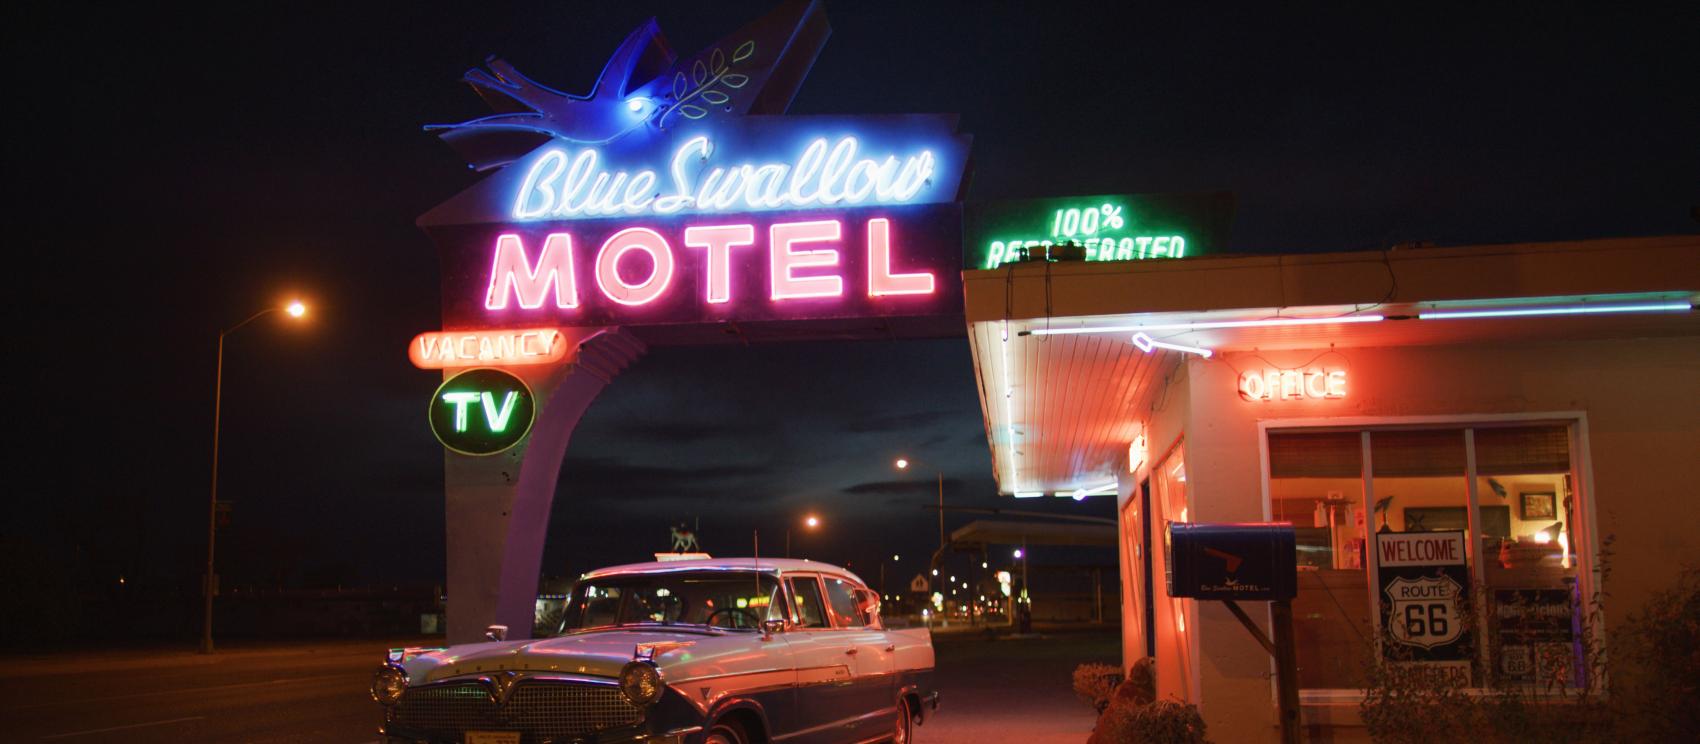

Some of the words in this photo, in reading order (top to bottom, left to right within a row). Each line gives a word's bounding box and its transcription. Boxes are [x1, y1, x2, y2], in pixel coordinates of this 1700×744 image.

[512, 148, 666, 219] Blue
[655, 136, 935, 213] Swallow
[1052, 203, 1125, 238] 100%
[485, 218, 935, 310] MOTEL
[418, 328, 559, 362] VACANCY
[1238, 369, 1347, 402] OFFICE
[441, 390, 519, 434] TV
[1382, 538, 1459, 563] WELCOME
[1401, 585, 1446, 598] ROUTE
[1405, 603, 1448, 637] 66
